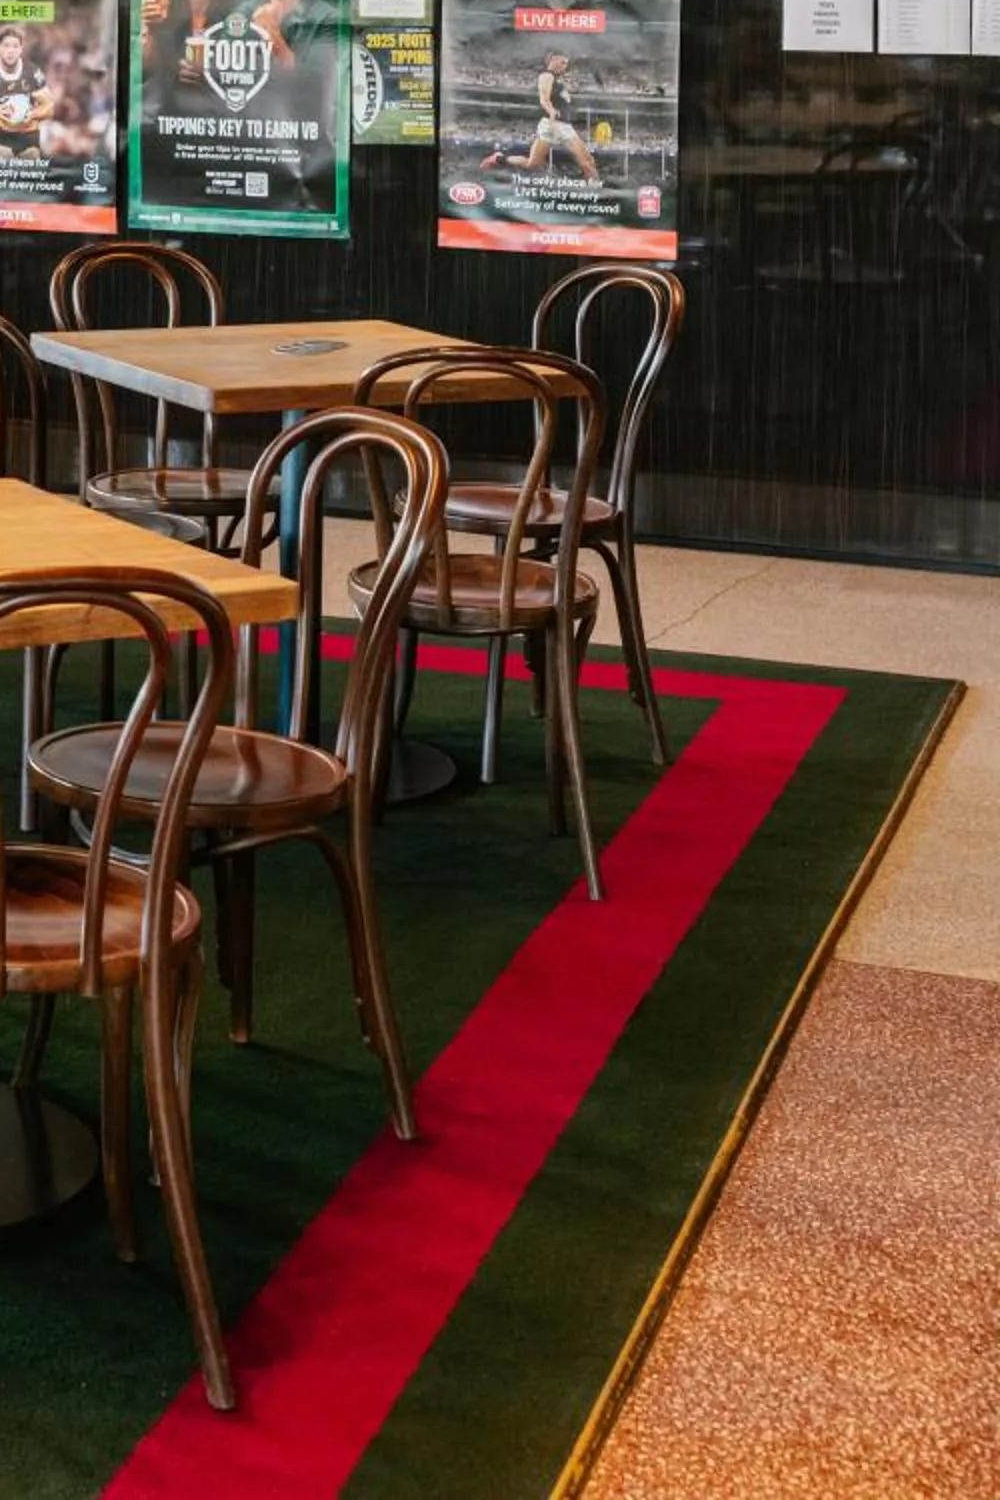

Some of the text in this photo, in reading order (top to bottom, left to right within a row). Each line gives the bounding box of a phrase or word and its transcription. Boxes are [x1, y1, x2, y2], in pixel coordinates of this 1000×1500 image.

[11, 5, 48, 18] HERE
[522, 13, 598, 29] LIVE HERE
[398, 33, 432, 49] FOOTY
[203, 39, 273, 71] FOOTY
[359, 49, 377, 122] STEEDEN
[157, 116, 319, 140] TIPPING'S KEY TO EARN VB
[36, 157, 50, 167] for
[20, 169, 47, 181] every
[512, 174, 530, 185] The
[531, 176, 554, 188] only
[557, 177, 585, 190] place
[9, 181, 34, 192] every
[36, 181, 64, 192] round
[515, 187, 600, 203] LIVE footy every
[494, 198, 620, 215] Saturday of every round
[531, 232, 582, 245] FOXTEL
